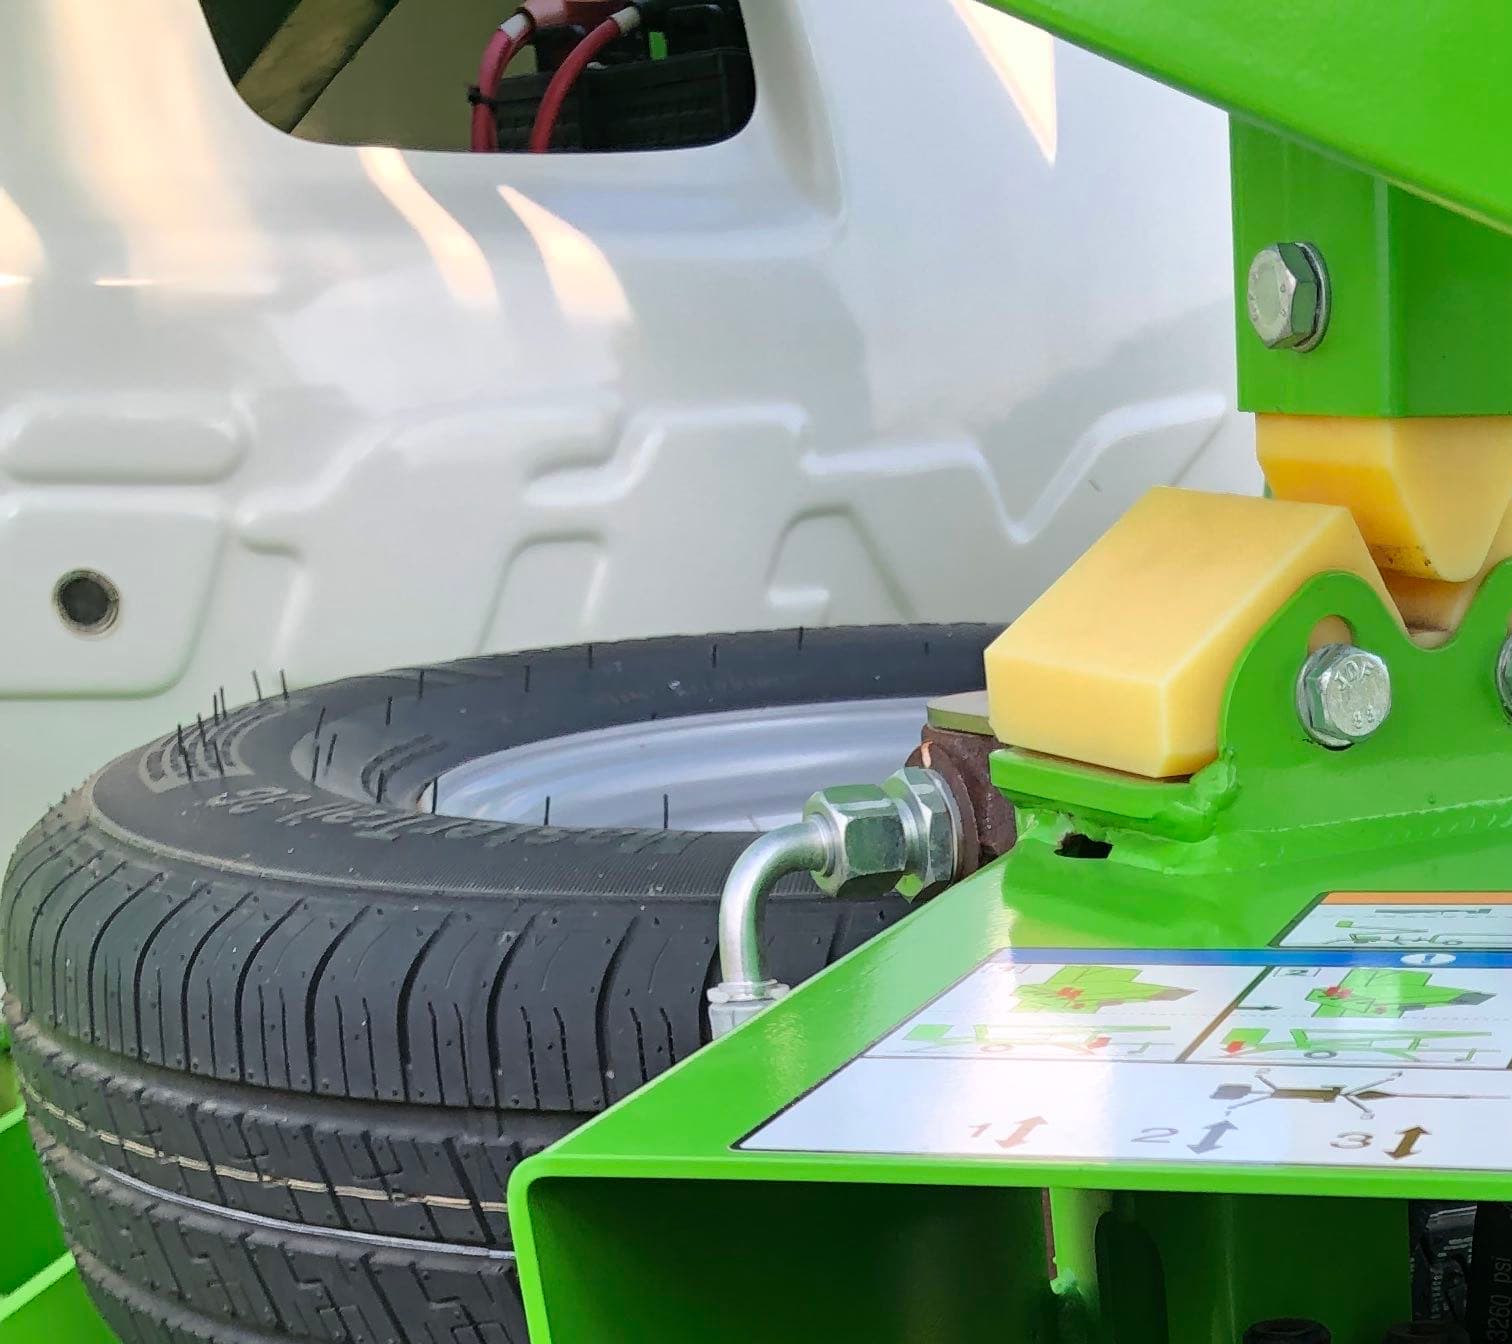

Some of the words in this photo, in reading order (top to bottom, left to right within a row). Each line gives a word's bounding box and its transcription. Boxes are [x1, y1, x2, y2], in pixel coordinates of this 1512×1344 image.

[968, 1122, 992, 1138] 1
[1130, 1126, 1179, 1144] 2
[1329, 1130, 1373, 1149] 3
[1487, 1293, 1512, 1343] 3260
